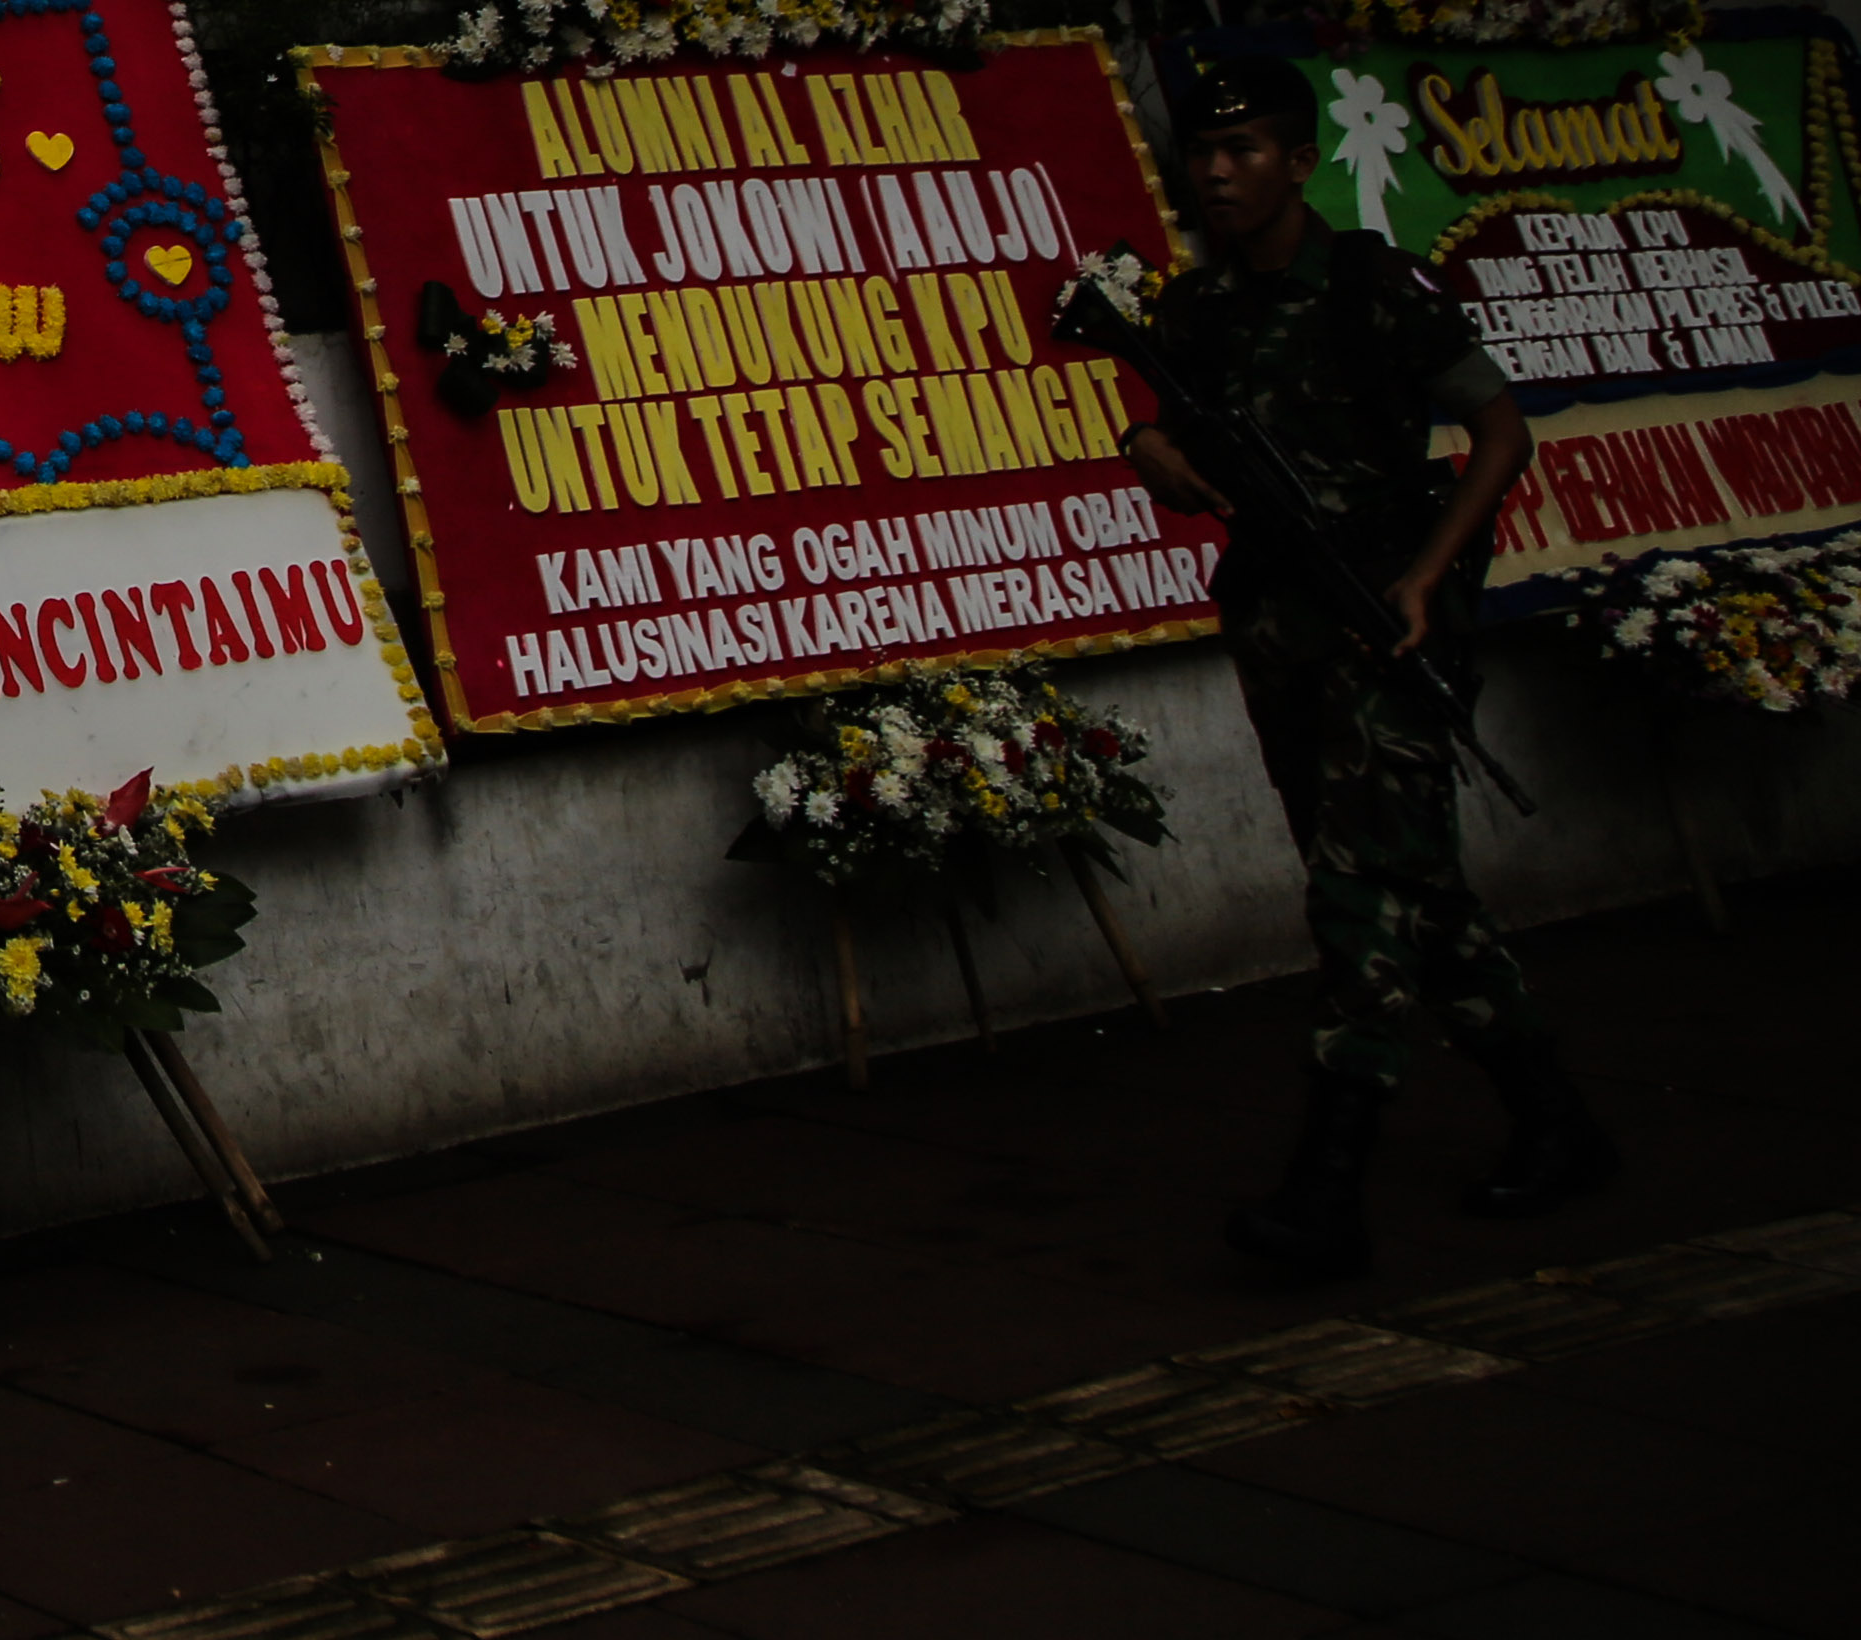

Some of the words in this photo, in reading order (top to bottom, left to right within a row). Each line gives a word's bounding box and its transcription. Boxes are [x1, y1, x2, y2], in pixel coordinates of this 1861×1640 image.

[519, 72, 737, 179] ALUMNI
[736, 71, 806, 168] AL
[804, 69, 981, 167] AZHAR
[1422, 72, 1681, 178] Selamat
[446, 184, 650, 299] UNTUK
[645, 175, 867, 285] JOKOWI
[860, 160, 1078, 281] (AAUJO)
[1465, 256, 1544, 298] YANG
[1537, 253, 1633, 294] TELAH
[1627, 247, 1760, 290] BERHASIL
[1513, 212, 1628, 252] KEPADA
[1624, 209, 1691, 248] KPU
[571, 274, 912, 402] MENDUKUNG
[907, 268, 1034, 373] KPU
[1652, 285, 1766, 329] PILPRES
[1758, 283, 1788, 322] &
[1780, 280, 1861, 320] PILEG
[1661, 330, 1691, 370] &
[1689, 324, 1778, 367] AMAN
[497, 400, 702, 514] UNTUK
[690, 382, 864, 501] TETAP
[857, 356, 1131, 480] SEMANGAT
[535, 543, 662, 615] KAMI
[654, 533, 786, 601] YANG
[792, 514, 927, 586] OGAH
[914, 499, 1064, 572] MINUM
[1060, 486, 1161, 552] OBAT
[504, 598, 791, 698] HALUSINASI
[788, 579, 955, 660] KARENA
[951, 559, 1122, 637] MERASA
